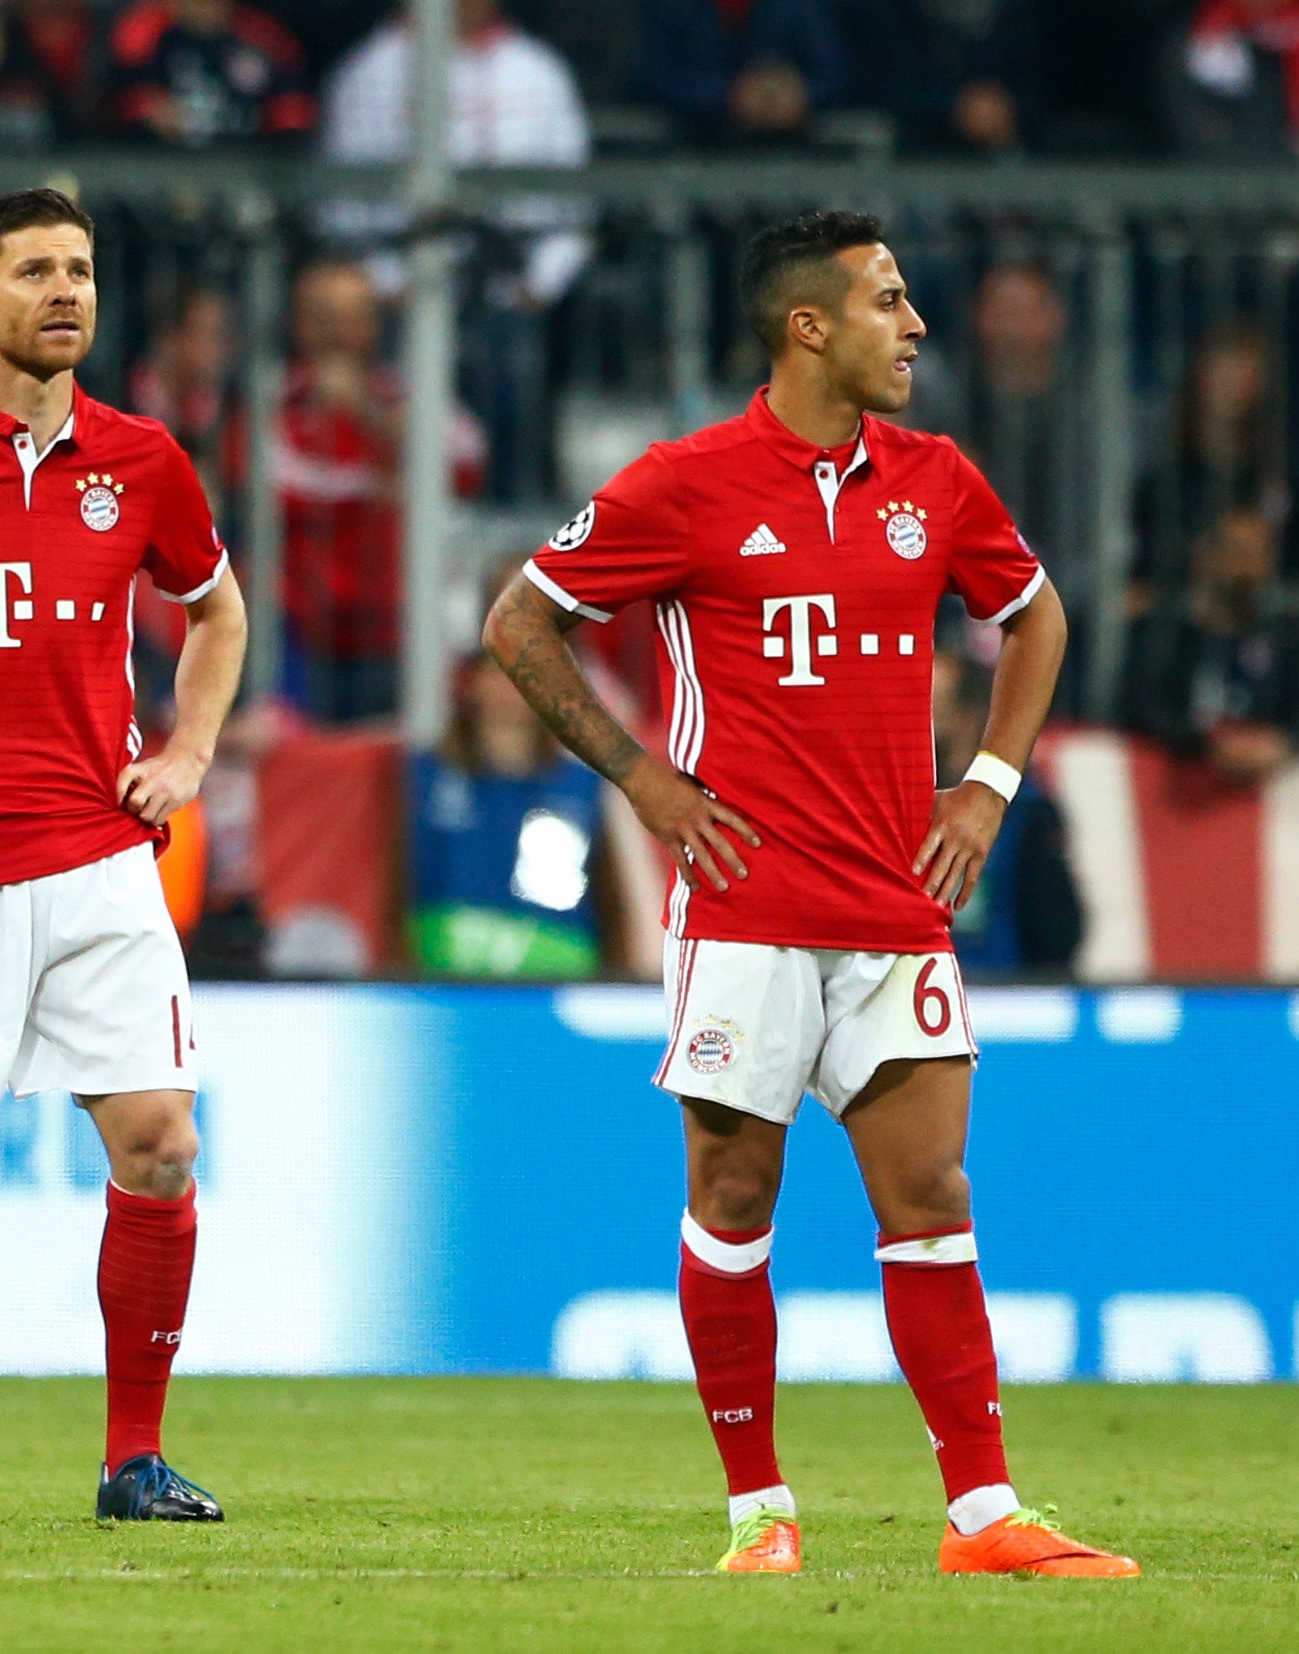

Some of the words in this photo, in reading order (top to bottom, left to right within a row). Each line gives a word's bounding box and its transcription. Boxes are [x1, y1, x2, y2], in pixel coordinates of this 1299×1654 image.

[739, 542, 787, 557] adidas
[913, 957, 951, 1037] 6
[171, 994, 196, 1068] 1
[703, 1031, 731, 1055] BAYERN
[151, 1329, 182, 1345] FC
[712, 1408, 753, 1423] FCB
